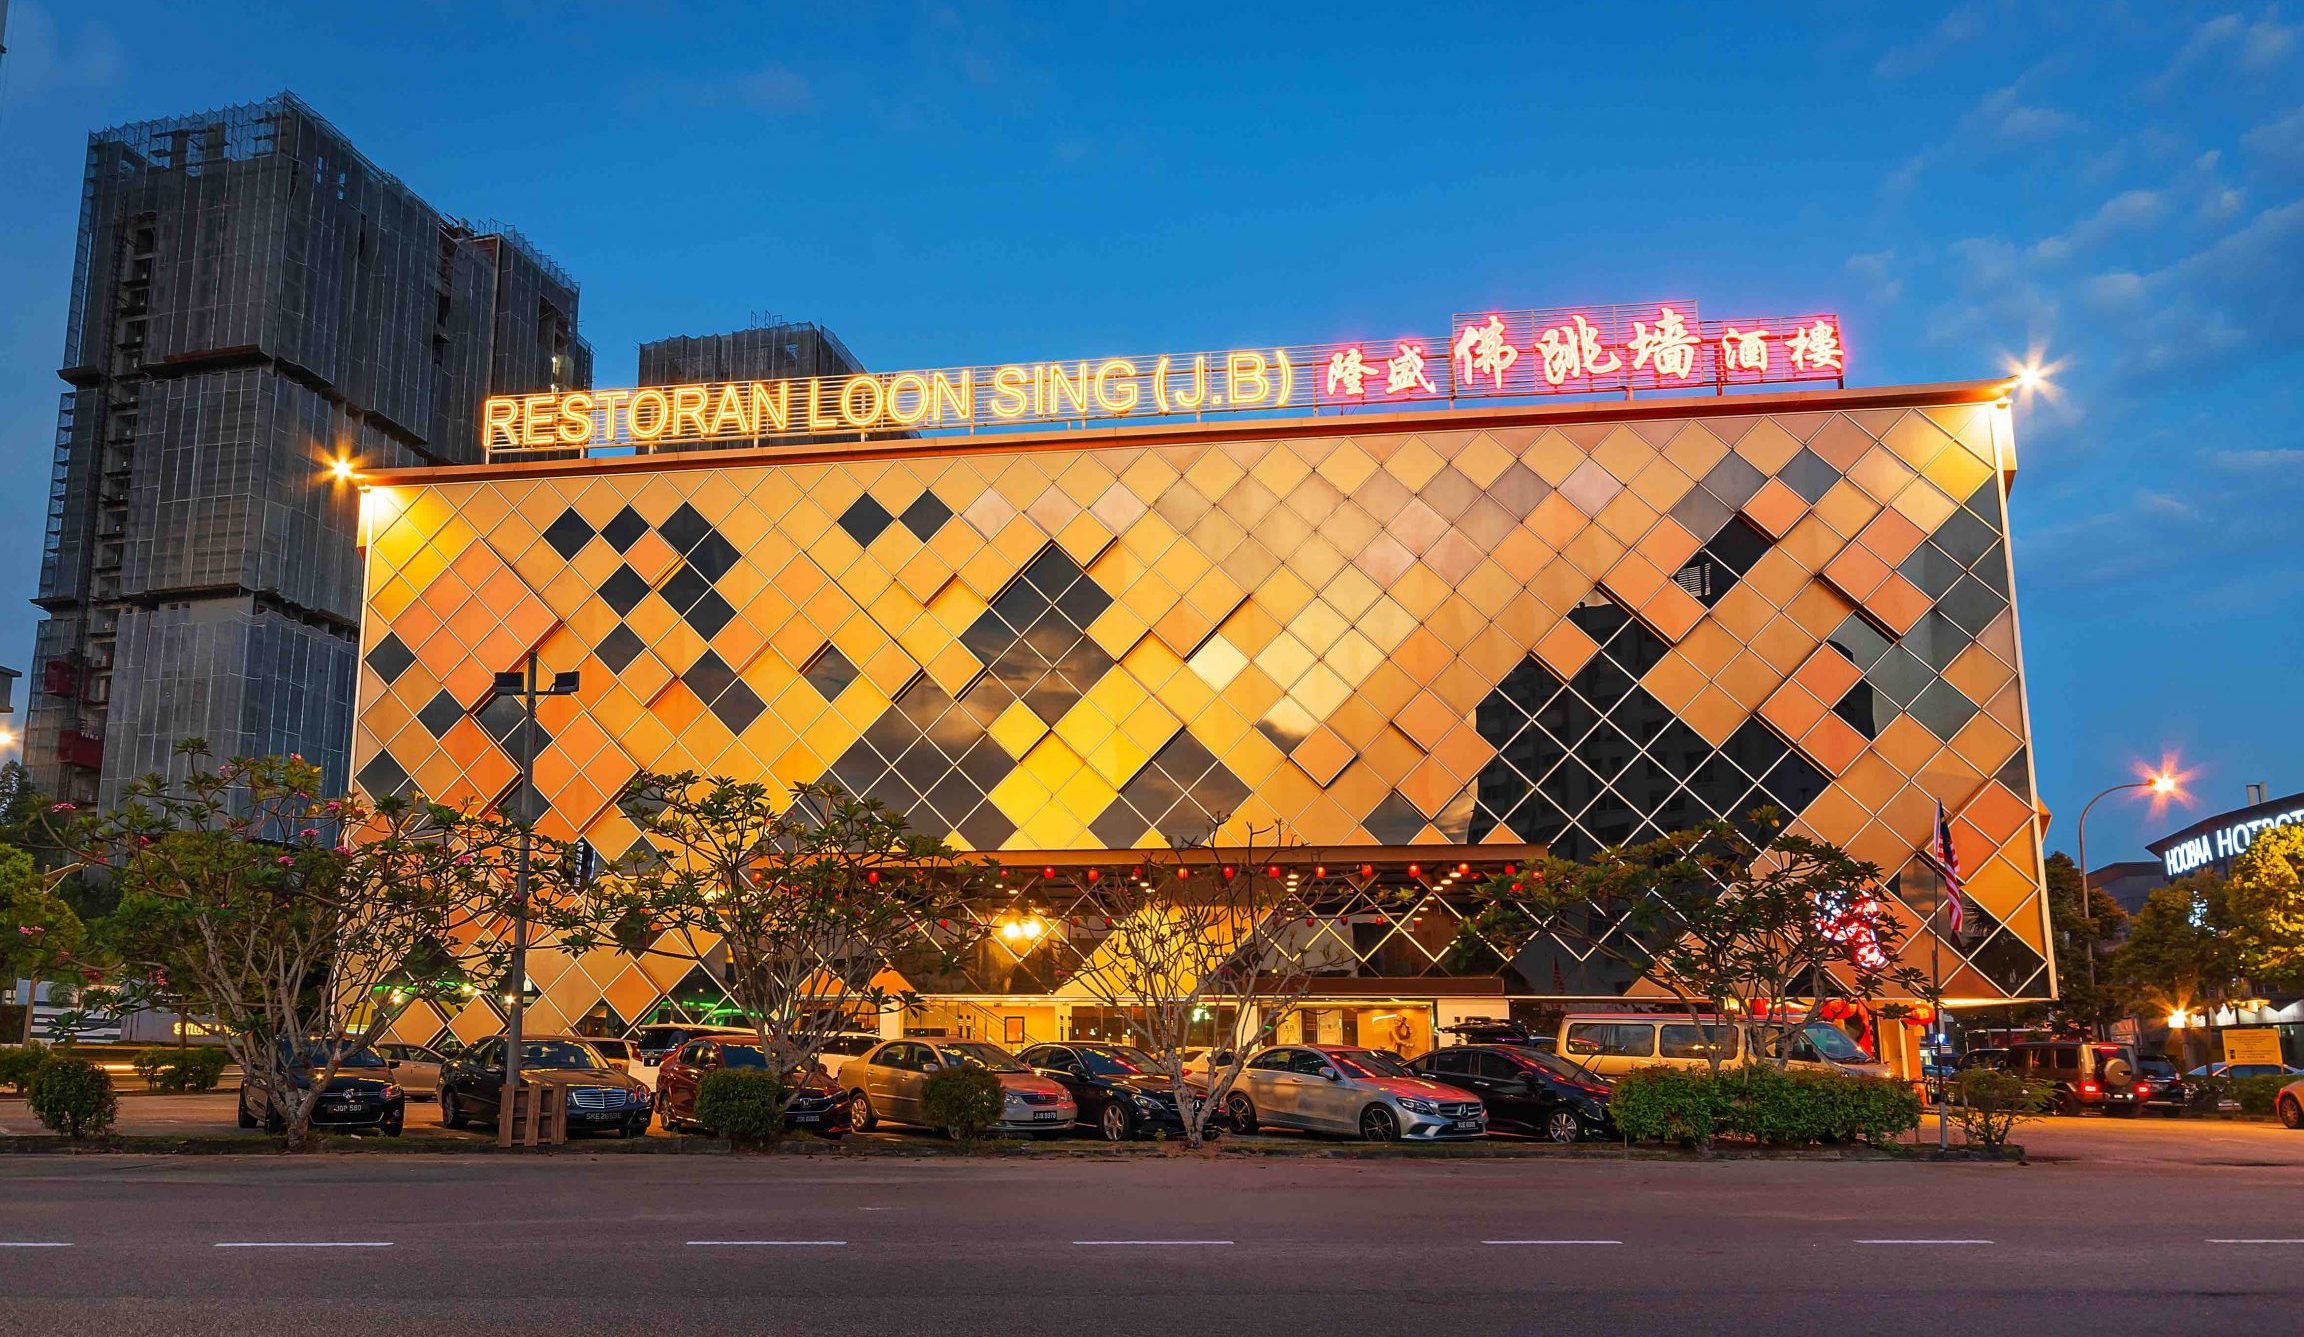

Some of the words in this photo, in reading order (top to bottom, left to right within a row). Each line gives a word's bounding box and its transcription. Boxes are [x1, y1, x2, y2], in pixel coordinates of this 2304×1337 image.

[482, 379, 790, 447] RESTORAN
[808, 369, 972, 429] LOON
[990, 359, 1140, 419] SING
[1152, 349, 1293, 413] (J.B)
